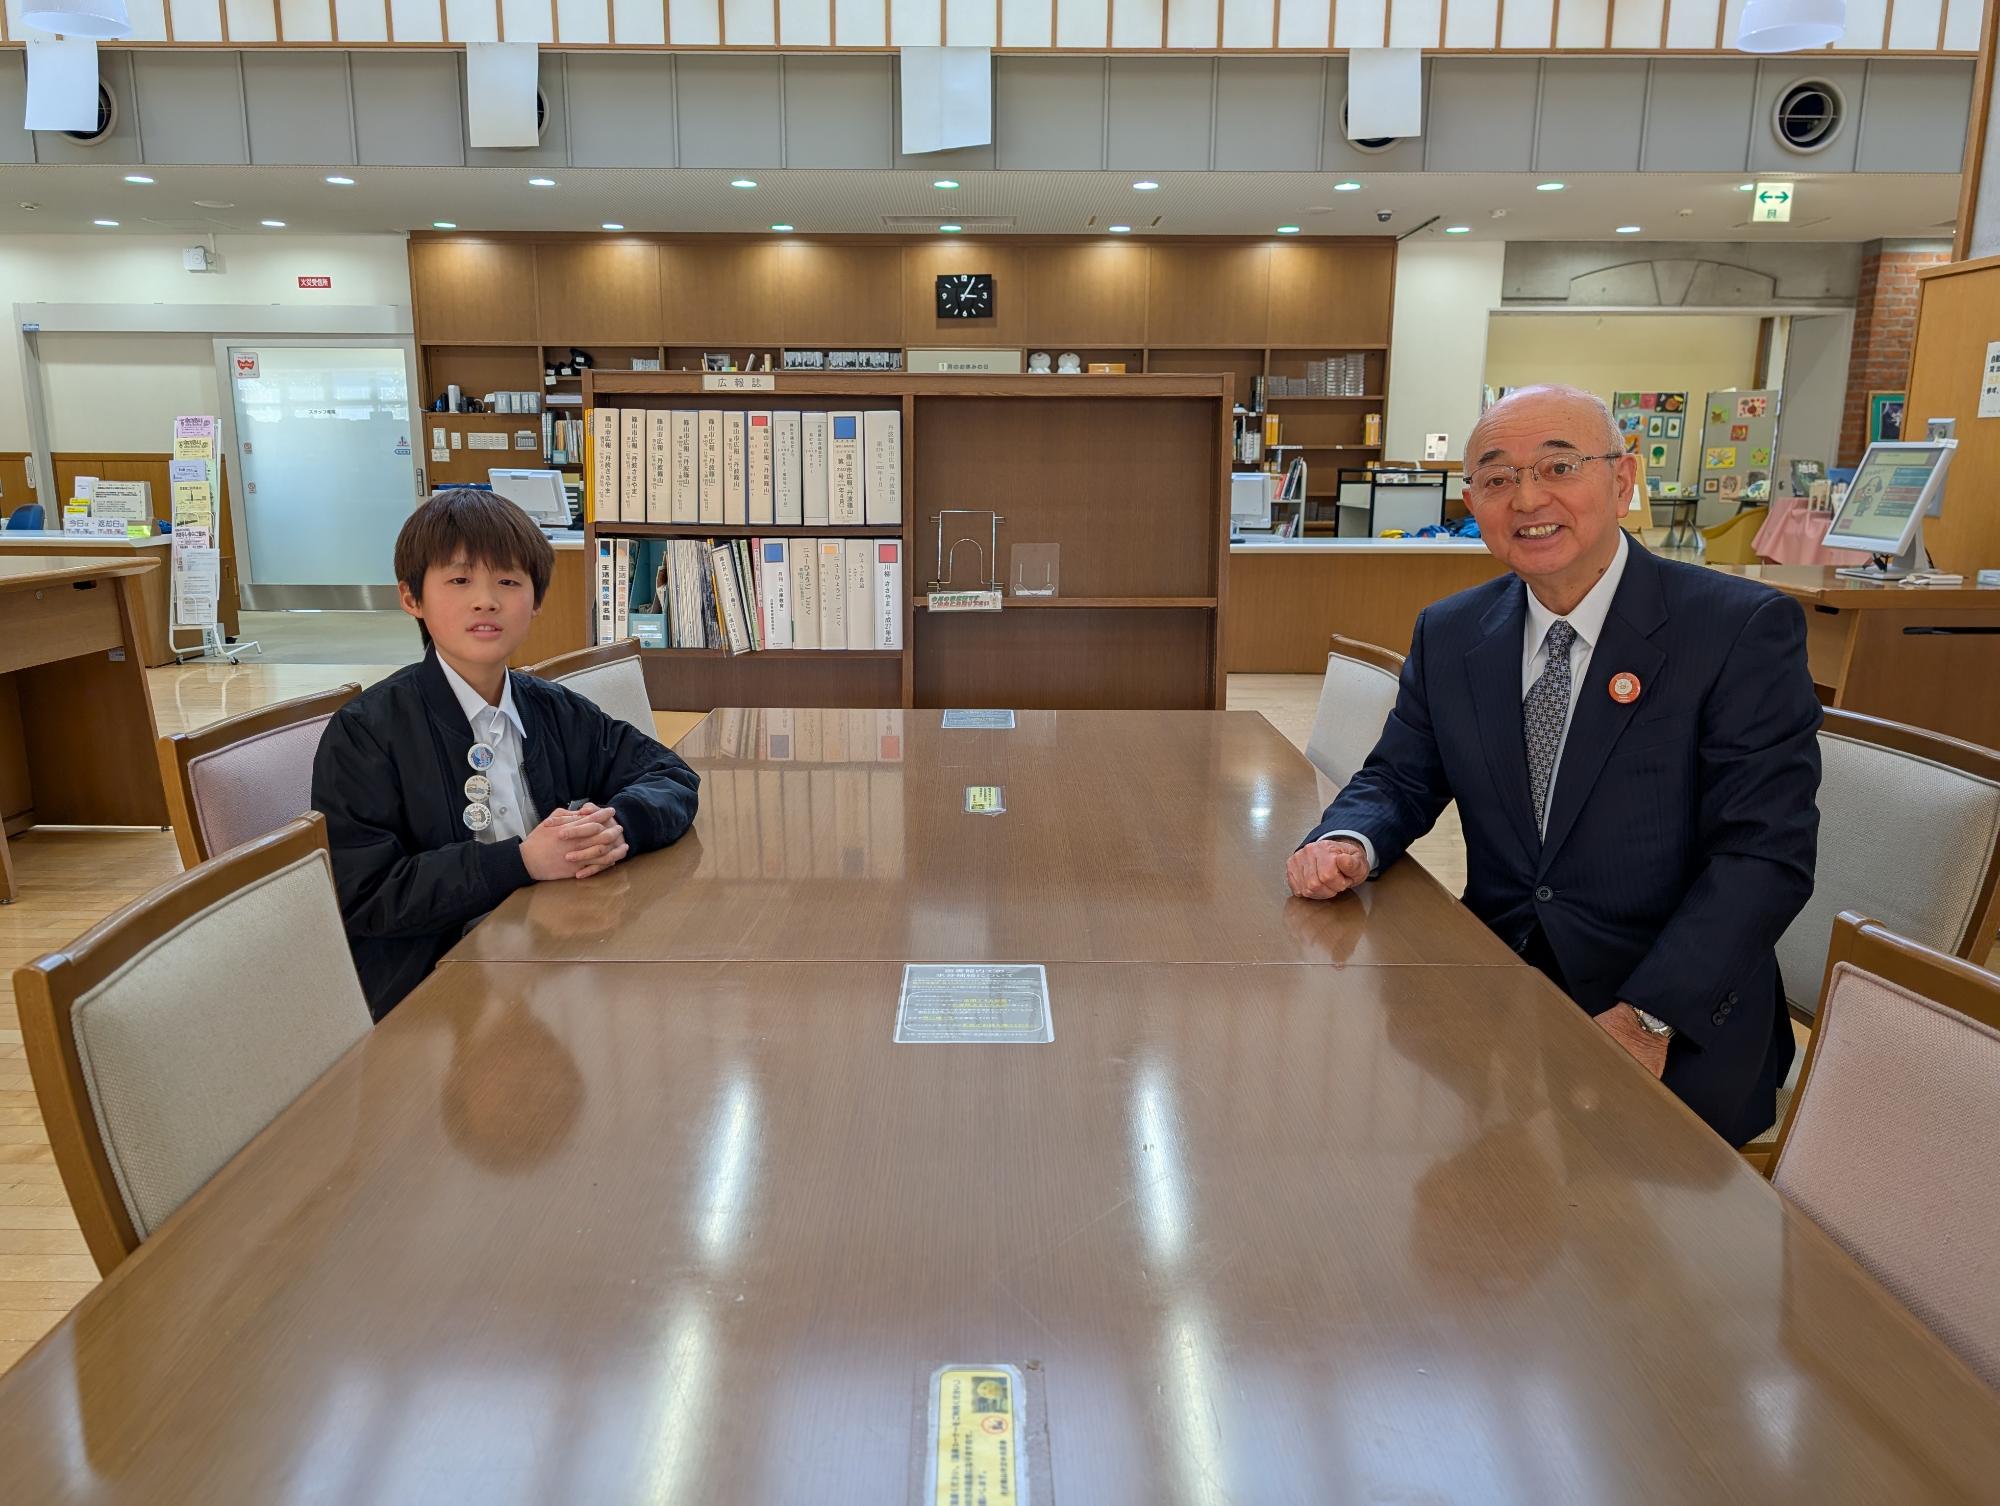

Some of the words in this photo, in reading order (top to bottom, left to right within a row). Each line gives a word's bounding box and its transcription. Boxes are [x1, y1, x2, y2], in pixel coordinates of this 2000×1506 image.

[942, 292, 948, 300] 9
[717, 377, 762, 388] 広報誌
